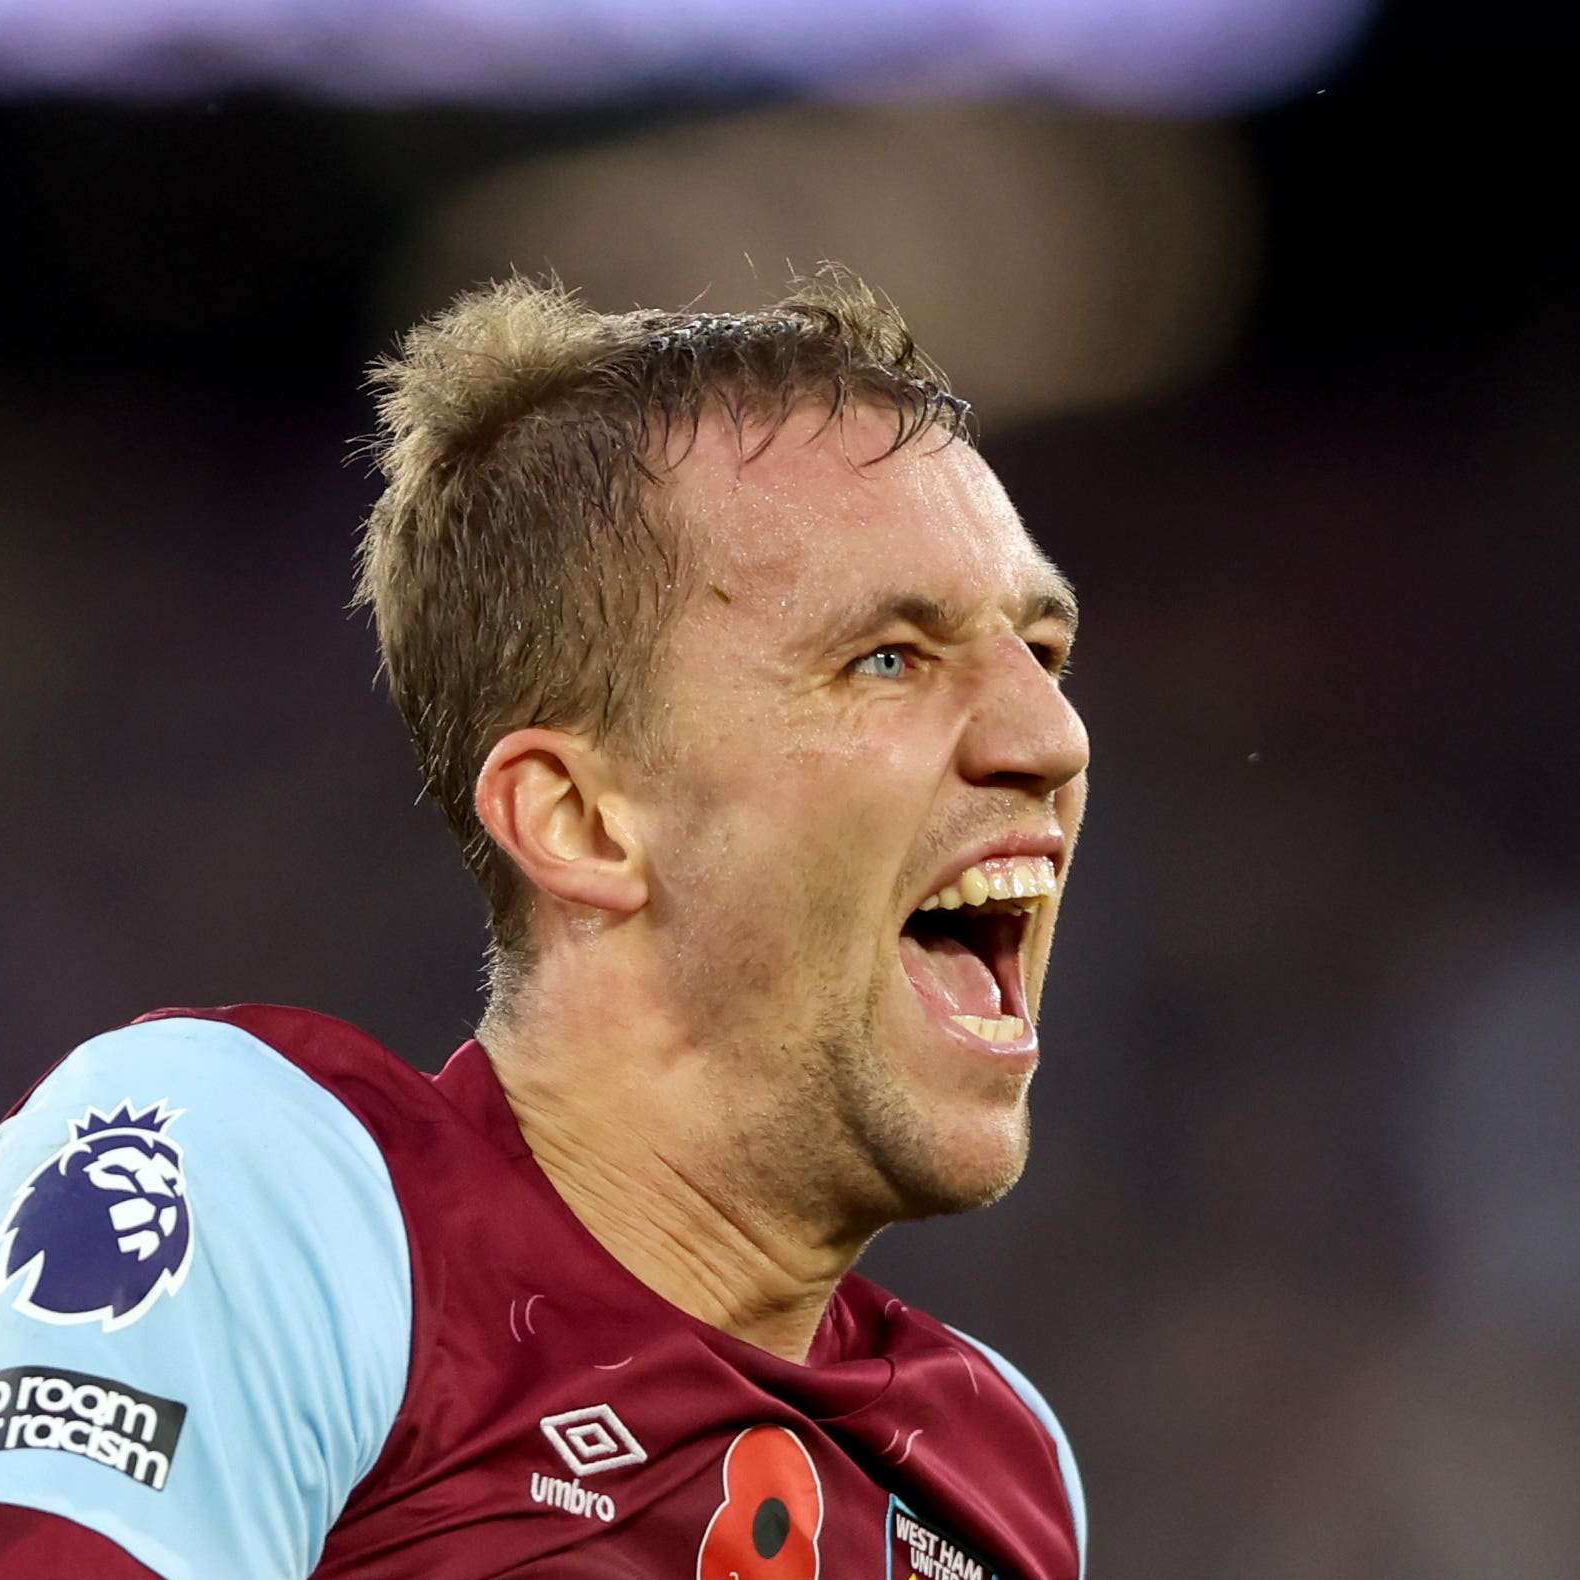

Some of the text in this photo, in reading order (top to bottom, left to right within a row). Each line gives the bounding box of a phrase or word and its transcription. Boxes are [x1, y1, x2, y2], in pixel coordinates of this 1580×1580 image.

[16, 1376, 158, 1442] room
[5, 1414, 169, 1490] racism
[531, 1472, 615, 1522] umbro
[896, 1513, 940, 1557] WEST
